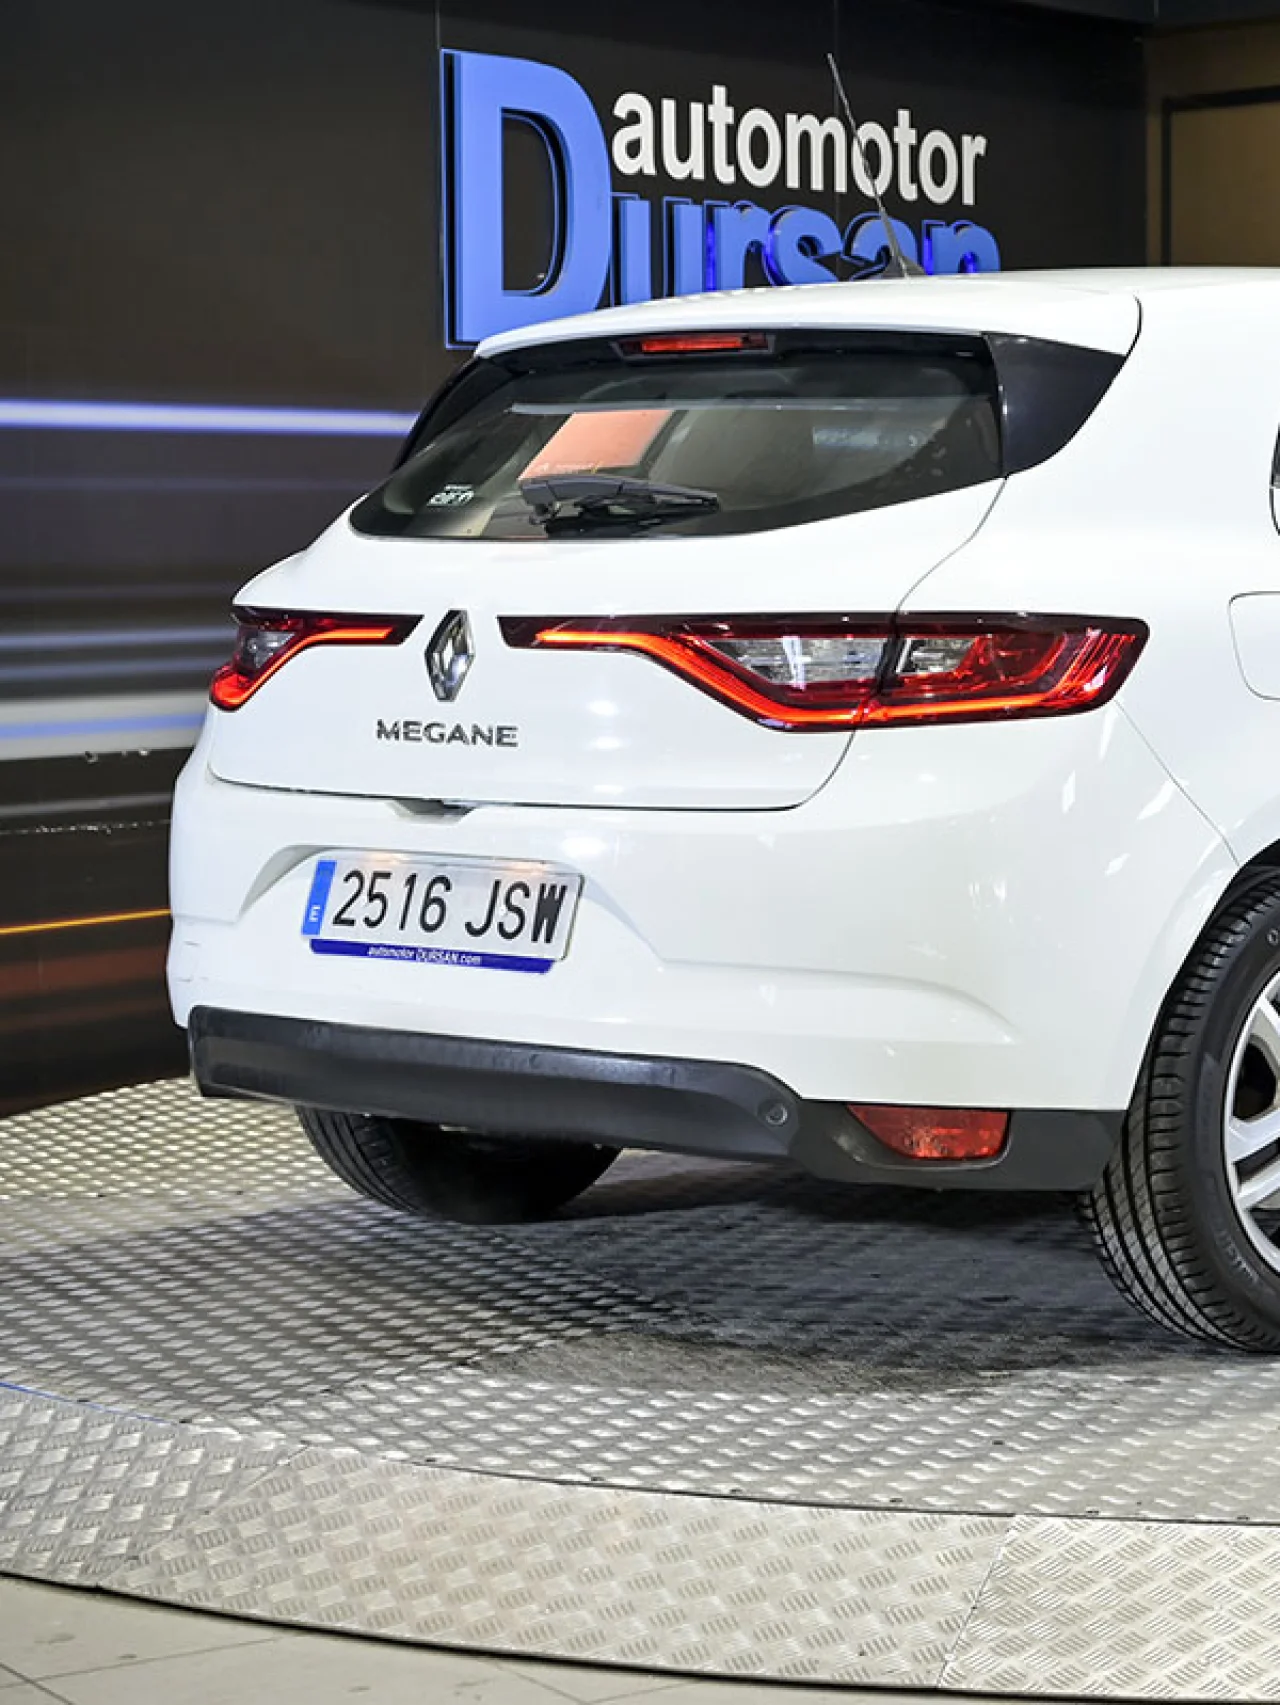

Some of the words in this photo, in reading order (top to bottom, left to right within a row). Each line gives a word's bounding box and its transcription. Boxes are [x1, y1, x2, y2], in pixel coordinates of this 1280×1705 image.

[612, 84, 987, 206] automotor
[376, 718, 519, 747] MEGANE
[331, 869, 453, 933] 2516
[464, 878, 568, 943] JSW
